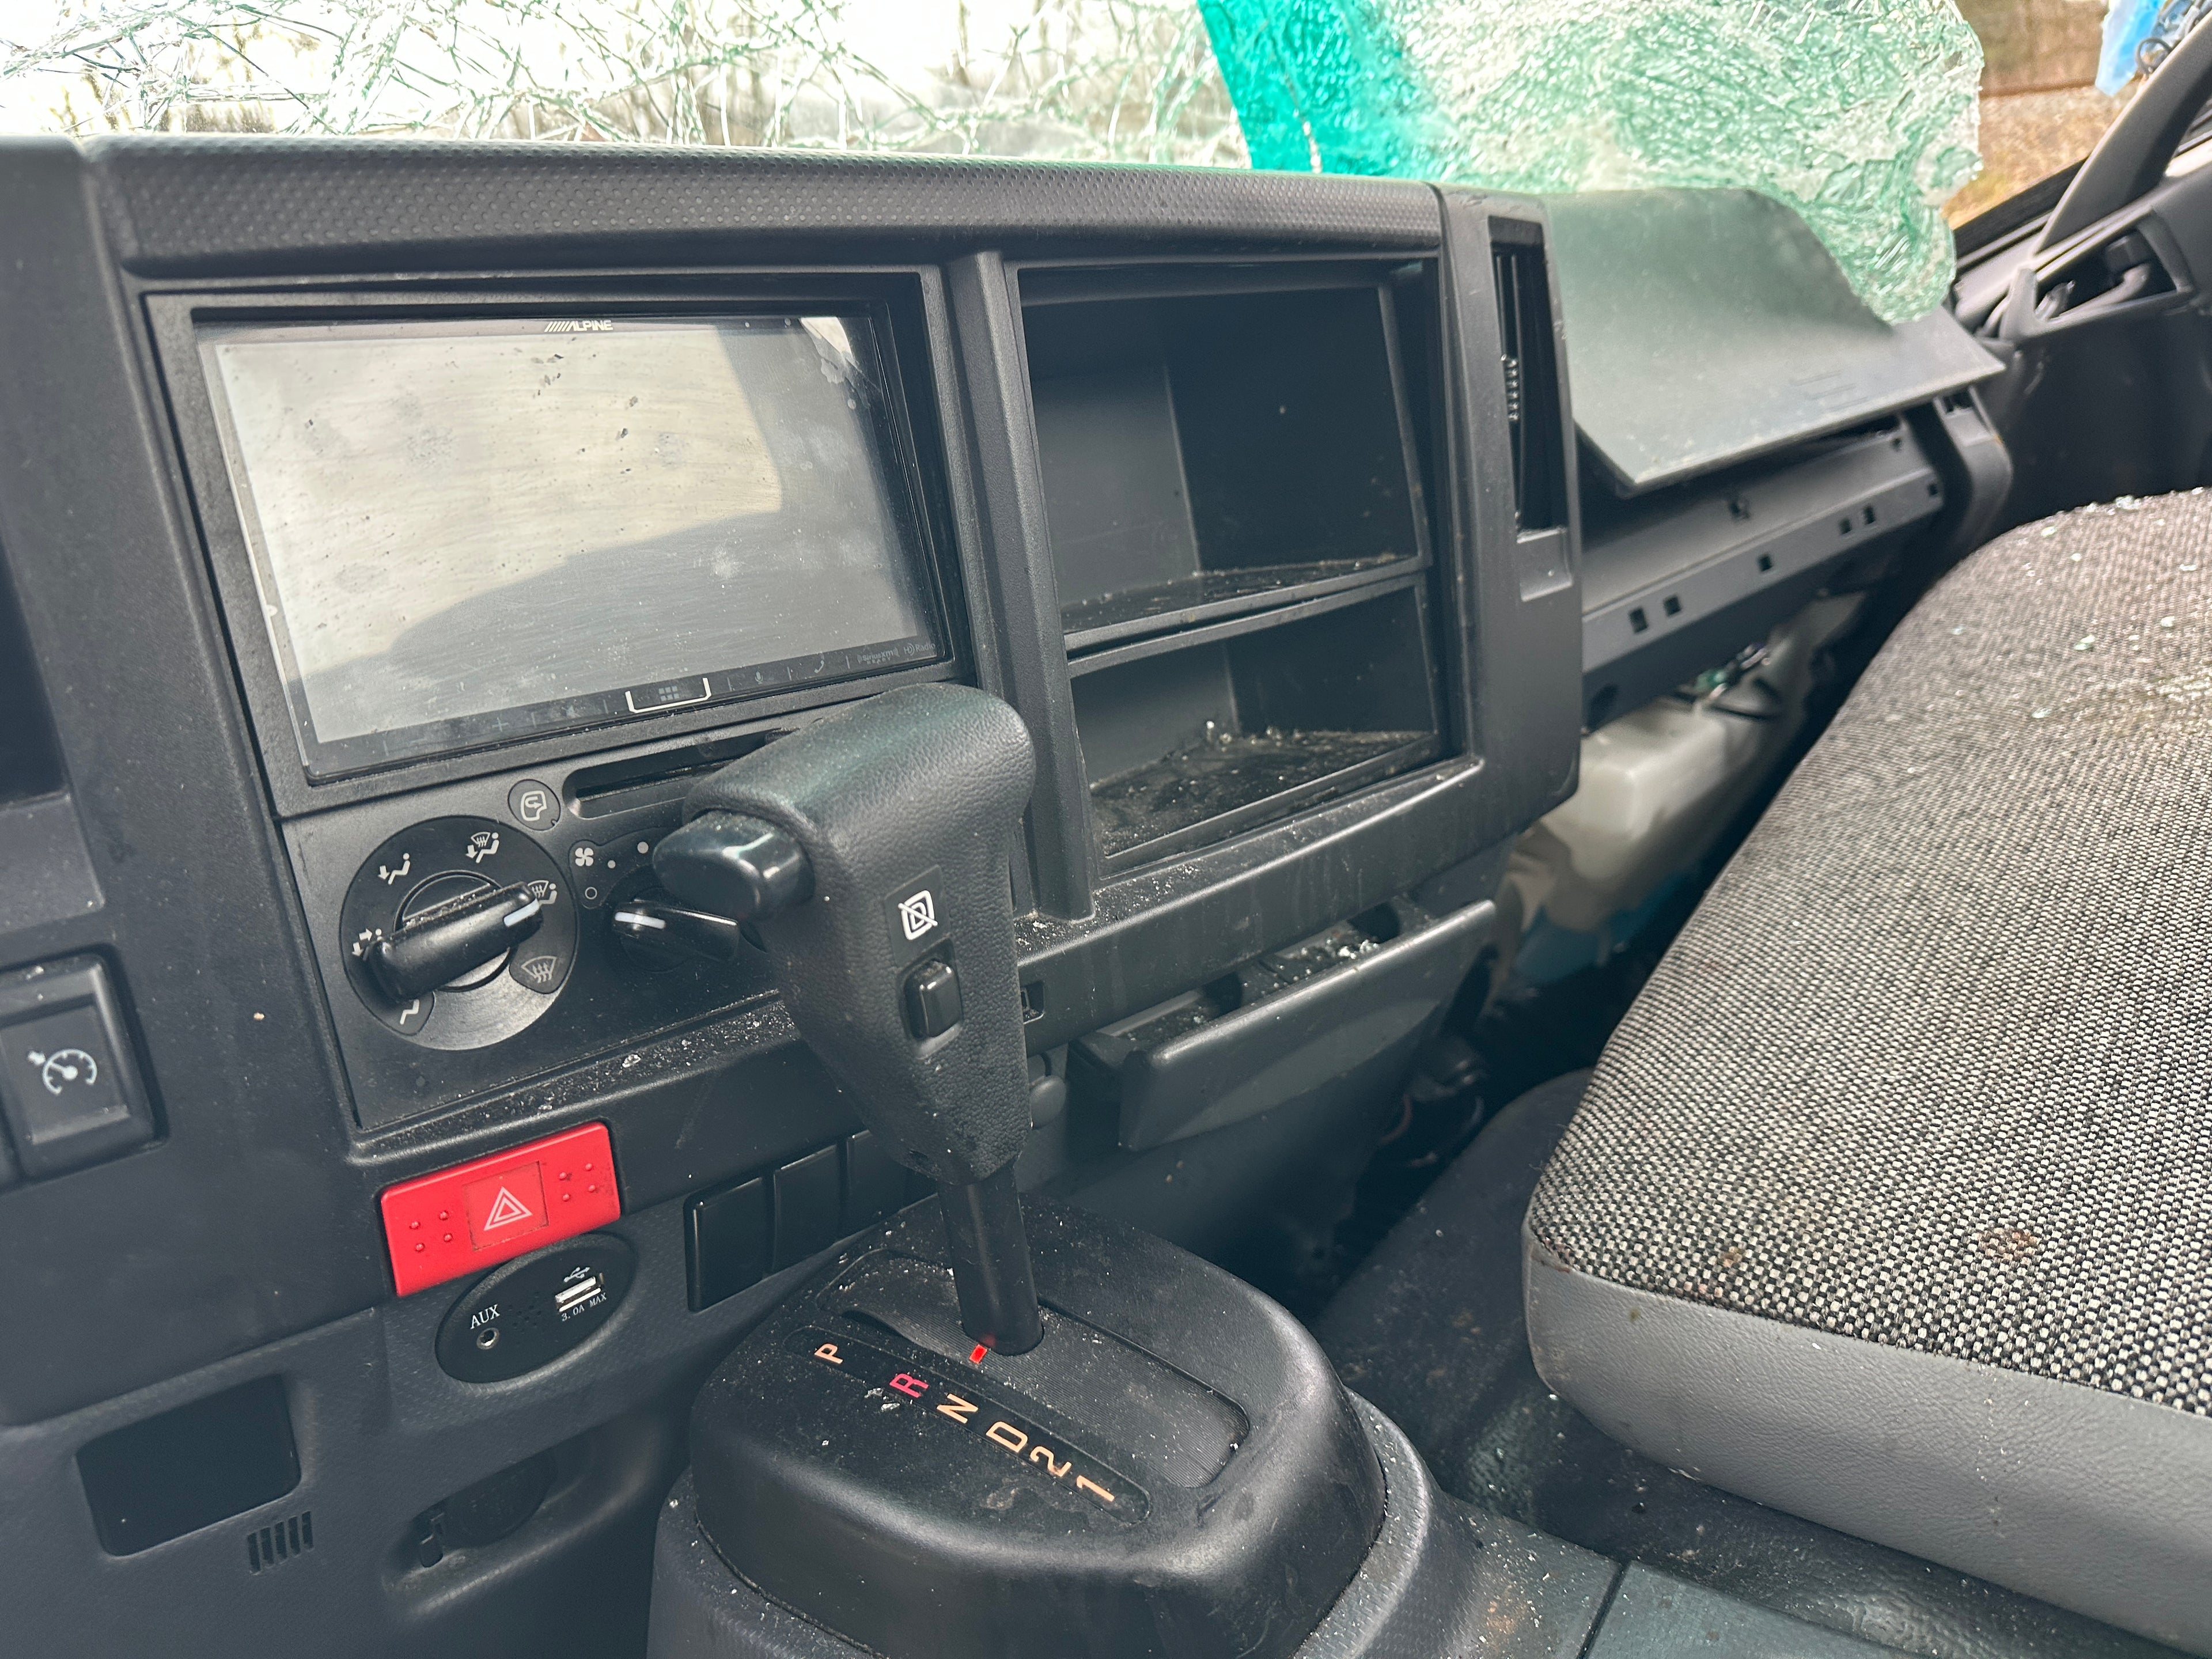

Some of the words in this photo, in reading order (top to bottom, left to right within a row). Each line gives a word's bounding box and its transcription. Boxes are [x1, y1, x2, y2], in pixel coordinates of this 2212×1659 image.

[566, 320, 613, 332] ALPINE
[915, 642, 935, 653] Radio
[589, 1293, 607, 1308] MAX
[471, 1304, 500, 1330] AUX
[814, 1343, 843, 1364] P
[889, 1373, 929, 1398] R
[937, 1393, 979, 1423] N
[986, 1421, 1028, 1453] D
[1029, 1445, 1072, 1477] 2
[1076, 1475, 1115, 1502] 1
